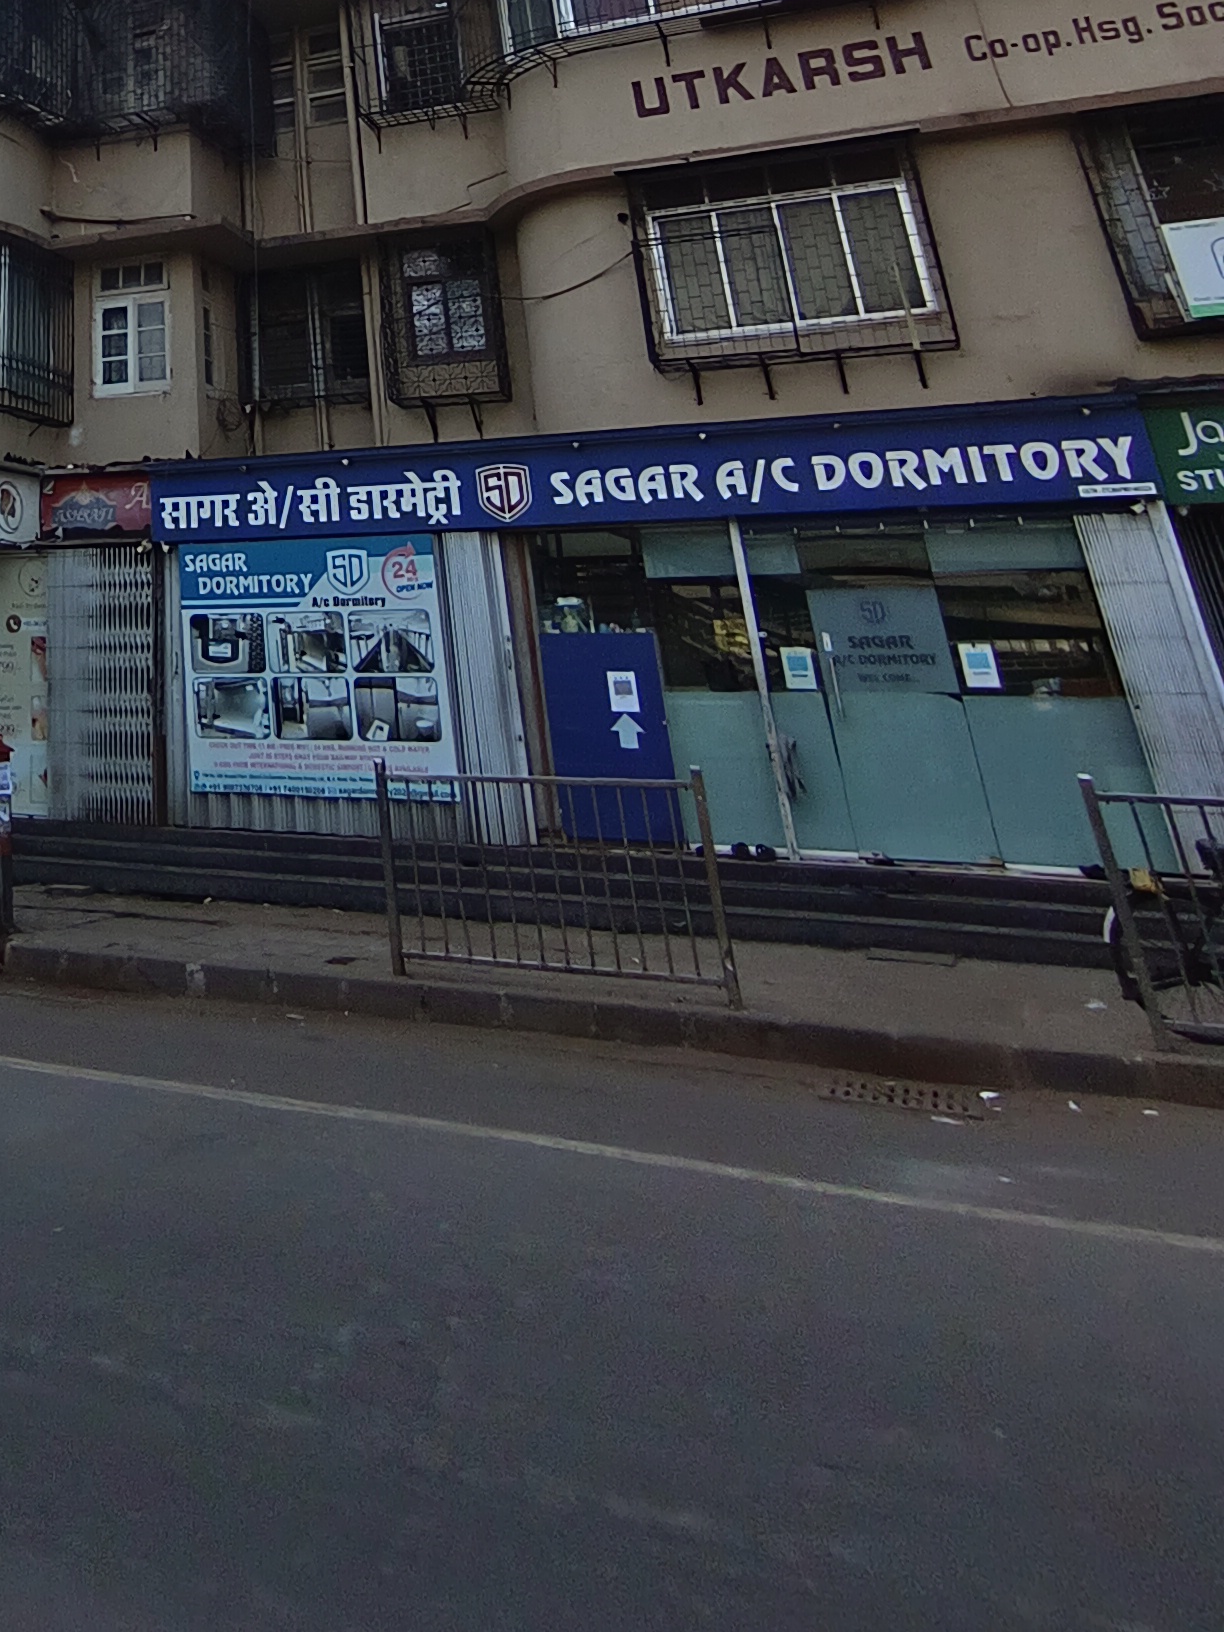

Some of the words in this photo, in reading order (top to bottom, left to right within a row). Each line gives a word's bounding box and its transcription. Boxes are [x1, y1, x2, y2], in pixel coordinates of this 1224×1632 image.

[631, 31, 934, 118] UTKARSH
[550, 463, 705, 508] SAGAR
[716, 457, 800, 504] A/C
[811, 435, 1133, 492] DORMITORY
[159, 493, 241, 529] सागर
[347, 469, 462, 525] डारमेट्री
[184, 552, 248, 573] SAGAR
[392, 559, 418, 579] 24
[198, 573, 313, 596] DORMITORY
[396, 583, 416, 593] OPEN
[311, 596, 330, 609] A/c
[332, 595, 386, 608] Dormitory
[847, 634, 915, 650] SAGAR
[858, 652, 937, 666] DORMITORY
